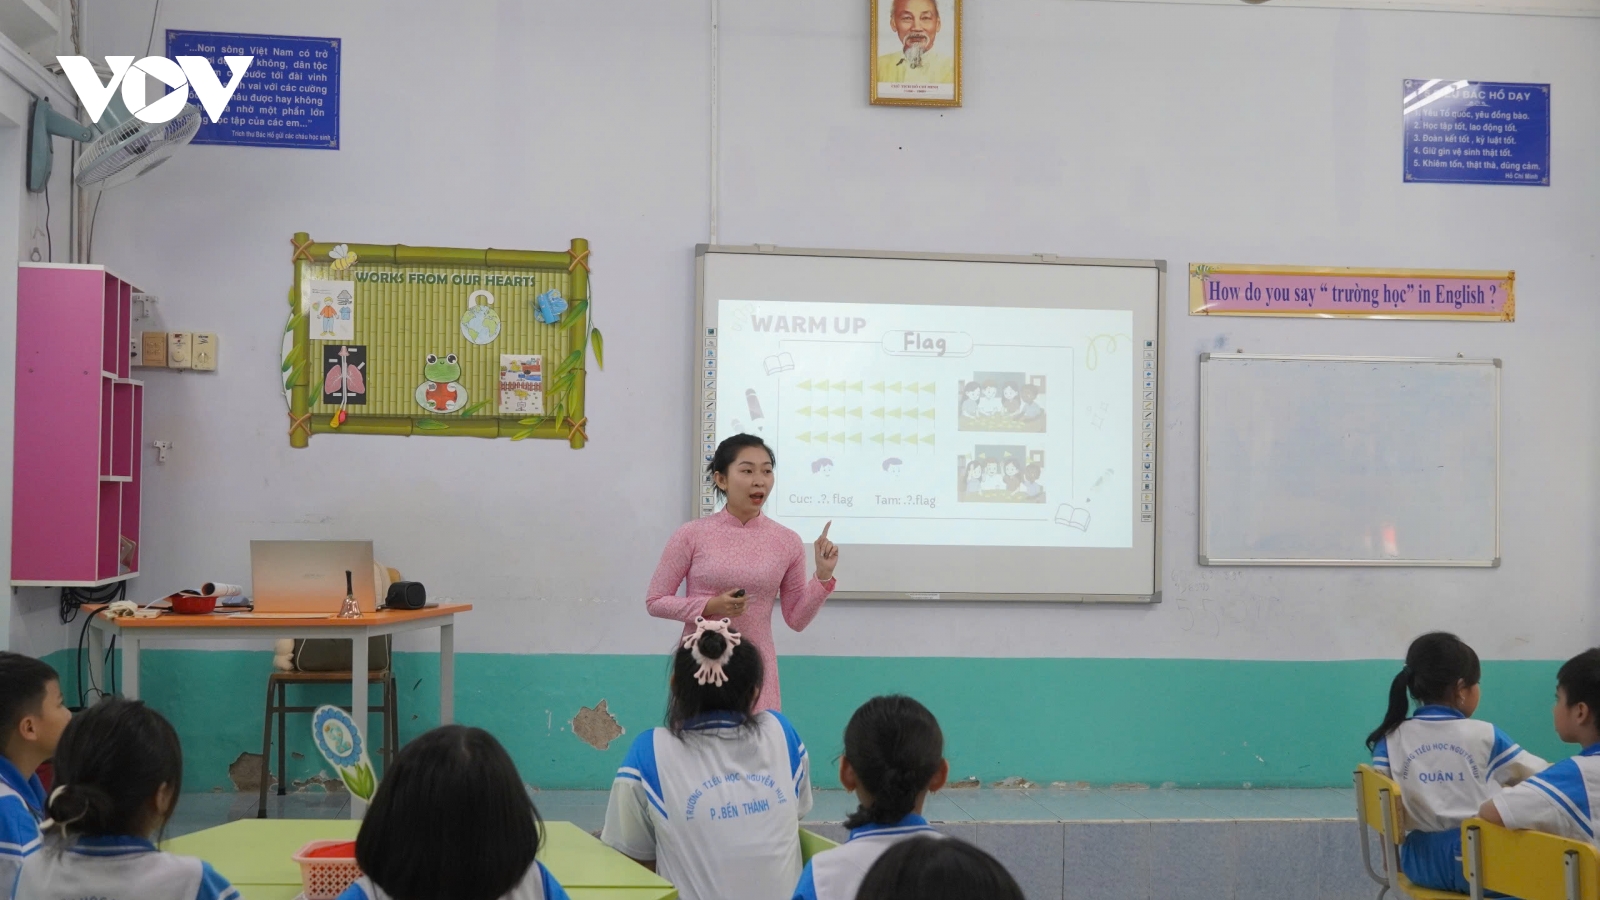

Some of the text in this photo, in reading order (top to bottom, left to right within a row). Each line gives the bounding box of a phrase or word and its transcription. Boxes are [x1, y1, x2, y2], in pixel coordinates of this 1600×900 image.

[221, 45, 245, 55] sông
[250, 46, 268, 56] Việt
[273, 48, 294, 57] Nam
[298, 49, 310, 57] có
[256, 59, 288, 69] không,
[293, 60, 310, 69] dân
[313, 62, 328, 71] tộc
[271, 71, 283, 80] tới
[288, 72, 303, 80] đài
[308, 73, 327, 81] vinh
[248, 82, 261, 90] vai
[264, 82, 278, 91] với
[280, 83, 297, 92] các
[250, 94, 273, 103] được
[275, 95, 292, 105] hay
[294, 95, 323, 106] không
[1508, 92, 1531, 102] DẠY
[259, 106, 277, 115] một
[310, 107, 325, 116] lớn
[1423, 109, 1438, 117] Yêu
[1475, 110, 1490, 120] yêu
[231, 116, 246, 126] tập
[248, 116, 265, 125] của
[267, 117, 284, 126] các
[1414, 121, 1420, 129] 2.
[1422, 121, 1438, 130] Học
[1440, 122, 1453, 131] tập
[1469, 122, 1481, 131] lao
[1482, 123, 1503, 134] động
[1504, 123, 1518, 132] tốt.
[1413, 134, 1421, 142] 3.
[1422, 134, 1443, 142] Đoàn
[1444, 133, 1457, 143] kết
[1487, 136, 1502, 145] luật
[1413, 146, 1421, 155] 4.
[1422, 146, 1437, 155] Giữ
[1452, 147, 1462, 157] vệ
[1463, 148, 1481, 156] sinh
[1482, 148, 1498, 158] thật
[1413, 159, 1421, 167] 5.
[1422, 159, 1448, 167] Khiêm
[1466, 160, 1482, 170] thật
[1500, 161, 1521, 172] dũng
[355, 271, 536, 287] WORKS FROM OUR HEARTS
[1208, 280, 1241, 301] How
[1244, 281, 1262, 302] do
[1265, 286, 1291, 307] you
[1294, 287, 1316, 308] say
[1332, 282, 1379, 308] trường
[1418, 284, 1431, 304] in
[1435, 284, 1486, 309] English
[750, 314, 867, 334] WARM UP
[903, 331, 946, 357] Flag
[788, 493, 812, 504] Cuc:
[832, 493, 854, 507] flag
[875, 494, 901, 505] Tam:
[1432, 743, 1449, 751] HỌC
[724, 772, 740, 783] HỌC
[1418, 769, 1465, 784] QUẬN 1
[742, 798, 770, 815] THÀNH
